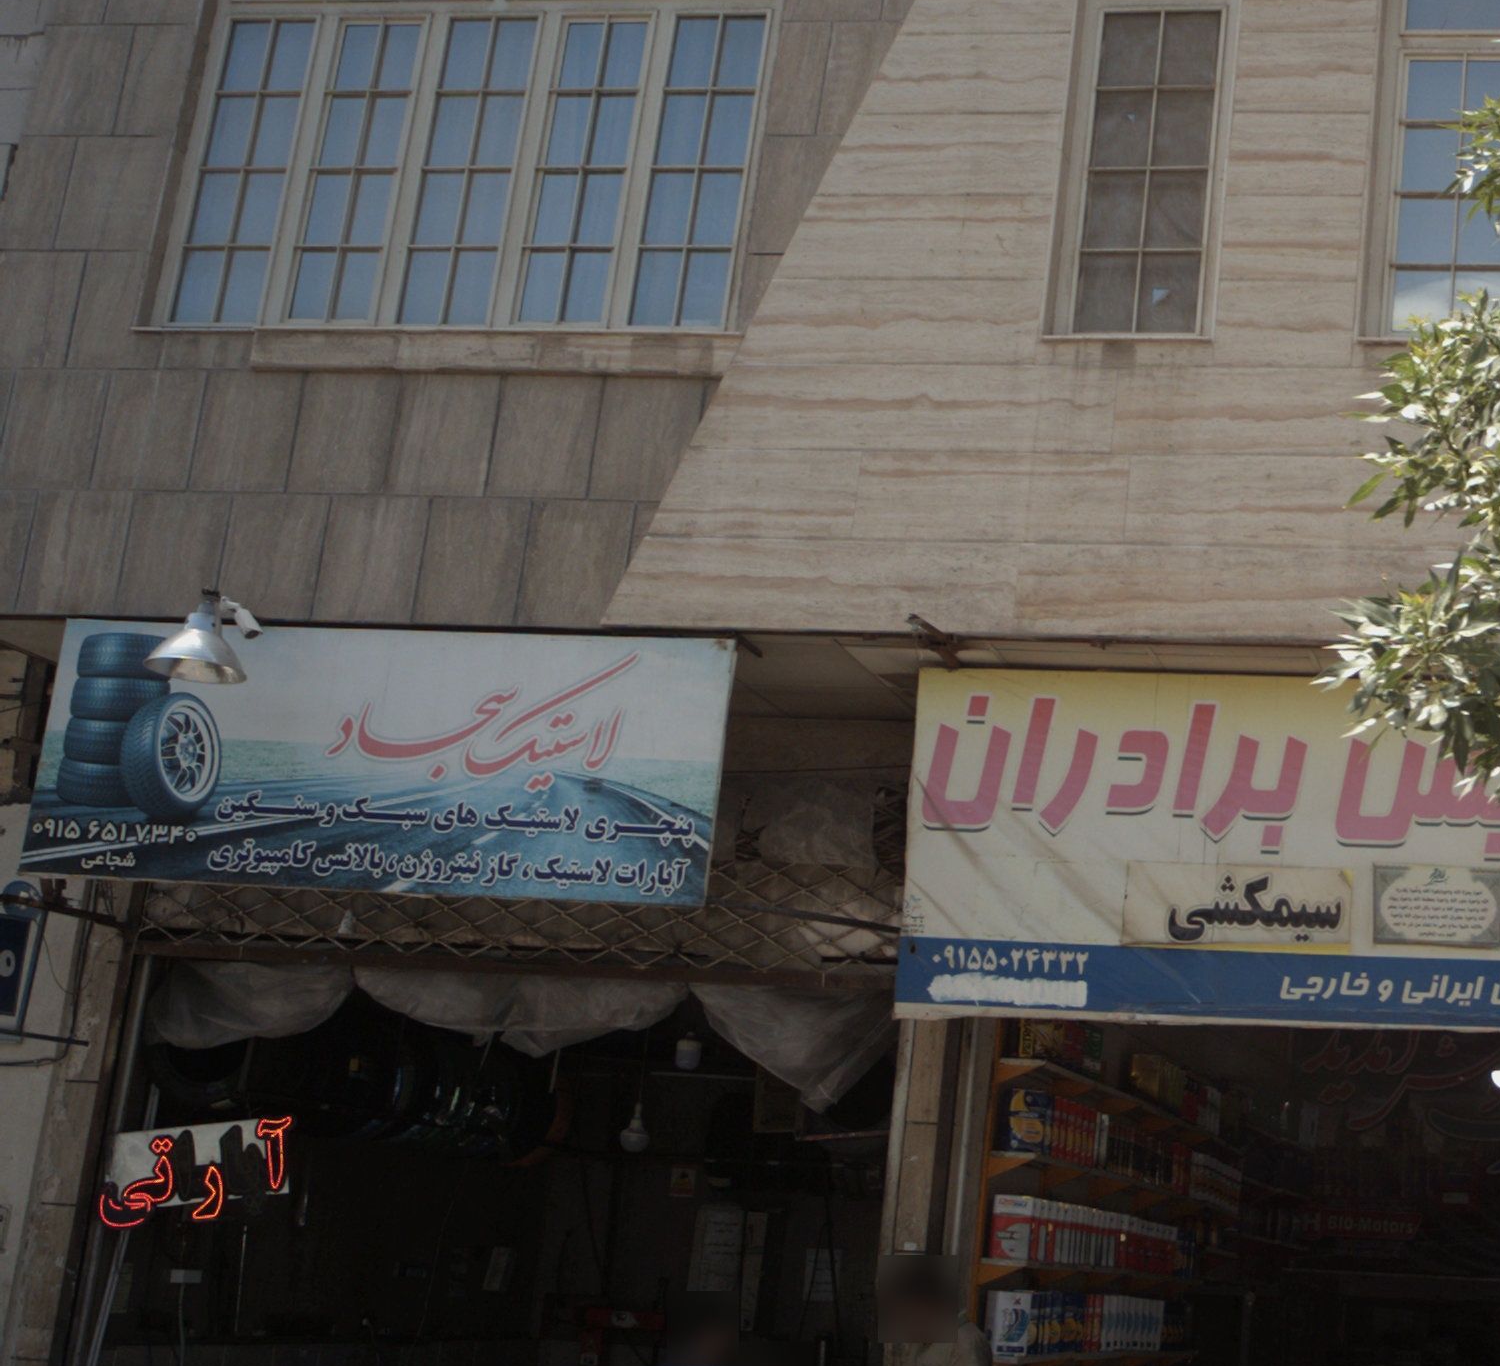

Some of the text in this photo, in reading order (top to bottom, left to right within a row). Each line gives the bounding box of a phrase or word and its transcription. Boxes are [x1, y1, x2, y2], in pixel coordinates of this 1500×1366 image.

[325, 653, 638, 791] لاستیک سجاد
[922, 695, 1308, 855] برادران
[32, 819, 199, 845] ۰۹۱۵ ۶۵۱ ۷۳۴۰
[215, 790, 695, 848] پنچری لاستیک های سبک و سنگین
[80, 848, 138, 870] شجاعی
[207, 838, 316, 875] کامپیوتری
[313, 842, 386, 879] بالانس
[481, 852, 518, 886] گاز
[614, 859, 690, 897] آپارات
[1167, 875, 1343, 942] سیمکشی
[932, 945, 1089, 975] ۰۹۱۵۵۰۲۴۳۳۲
[1280, 973, 1370, 1003] خارجی
[1378, 983, 1393, 1003] و
[1402, 975, 1485, 1009] ایرانی
